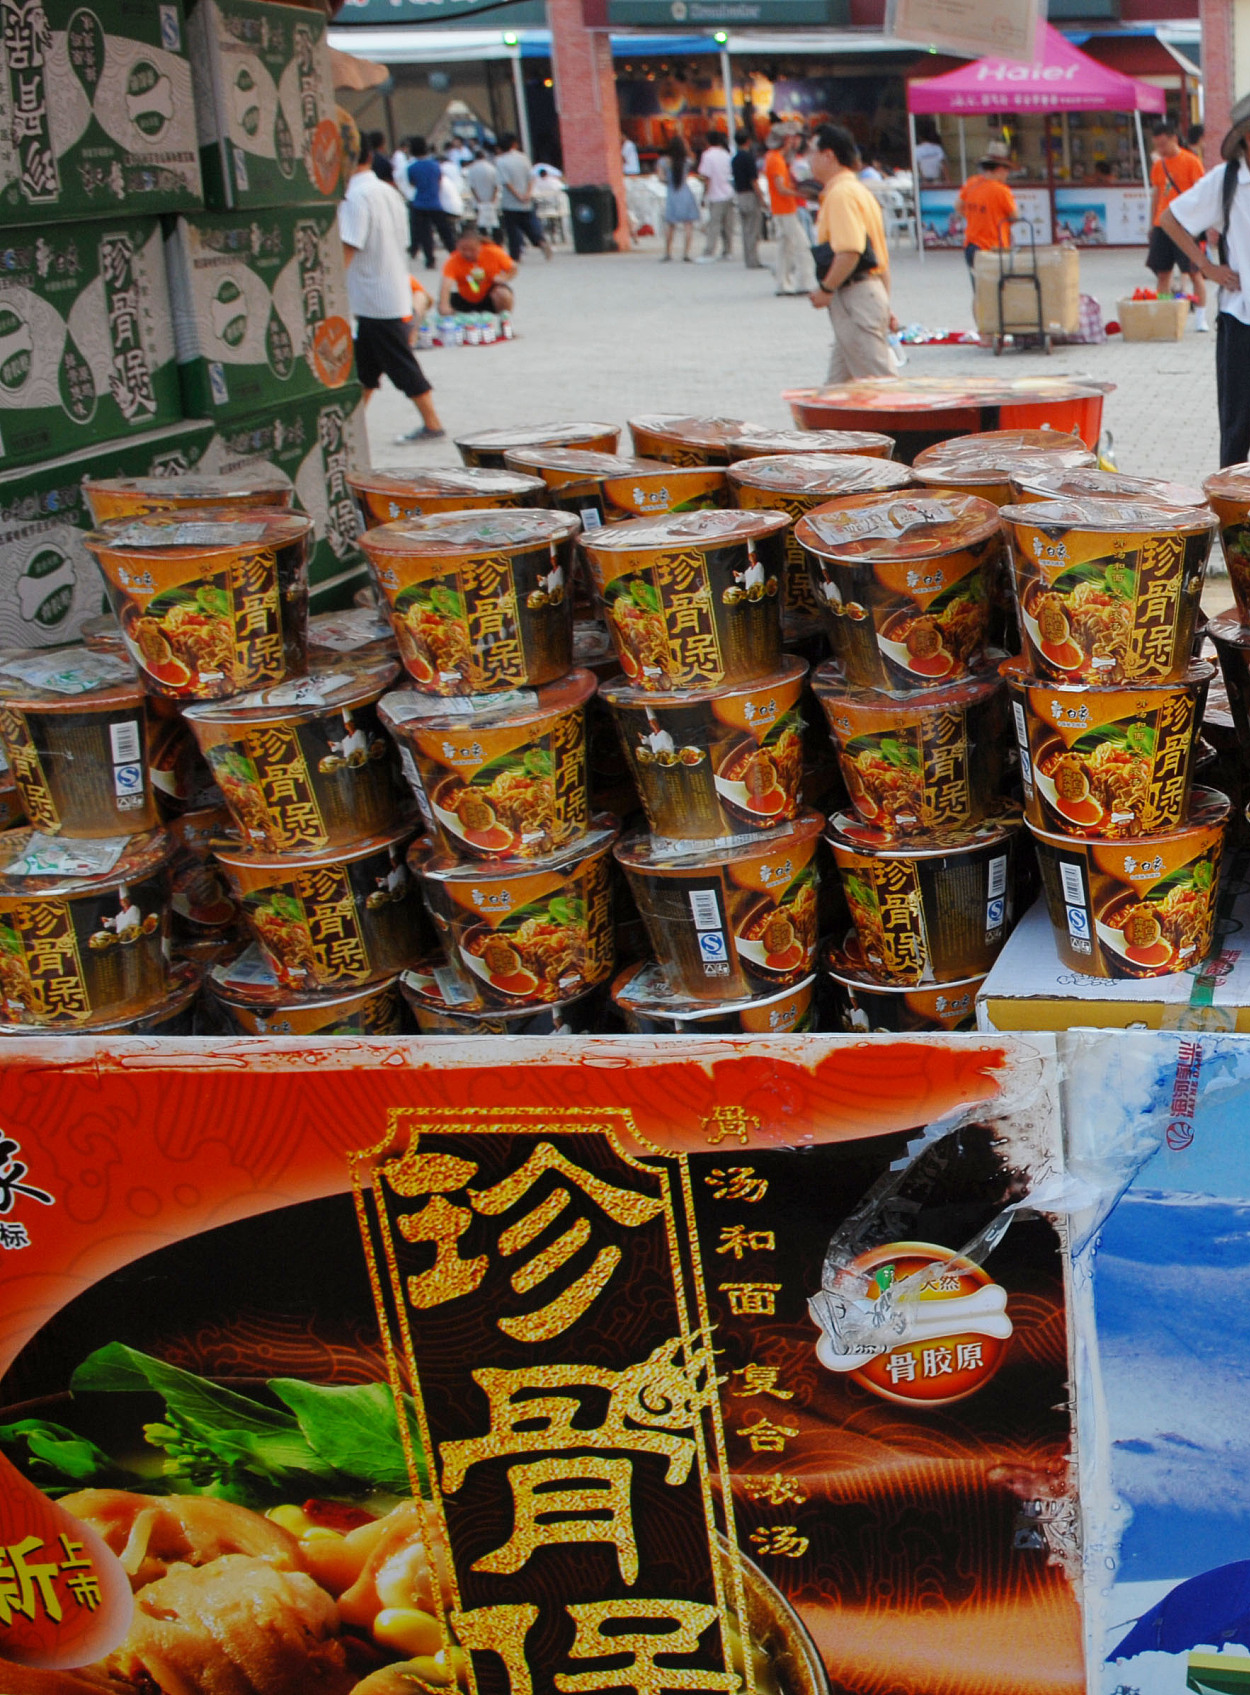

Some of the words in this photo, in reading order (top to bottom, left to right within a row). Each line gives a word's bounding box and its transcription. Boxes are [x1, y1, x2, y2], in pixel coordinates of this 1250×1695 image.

[977, 62, 1080, 82] Haier
[101, 237, 157, 420] 珍骨煲
[230, 552, 285, 685] 珍骨煲
[460, 558, 528, 689] 珍骨煲
[656, 552, 725, 687] 珍骨煲
[1125, 537, 1183, 678] 珍骨煲
[247, 728, 330, 850] 珍骨煲
[552, 711, 588, 844] 珍骨煲
[921, 711, 970, 828] 珍骨煲
[1142, 695, 1195, 829] 珍骨煲
[16, 901, 93, 1022] 珍骨煲
[297, 868, 372, 985] 珍骨煲
[872, 860, 928, 974] 珍骨煲
[886, 1341, 986, 1385] 骨胶原
[0, 1537, 59, 1626] 新
[59, 1533, 102, 1613] 上市
